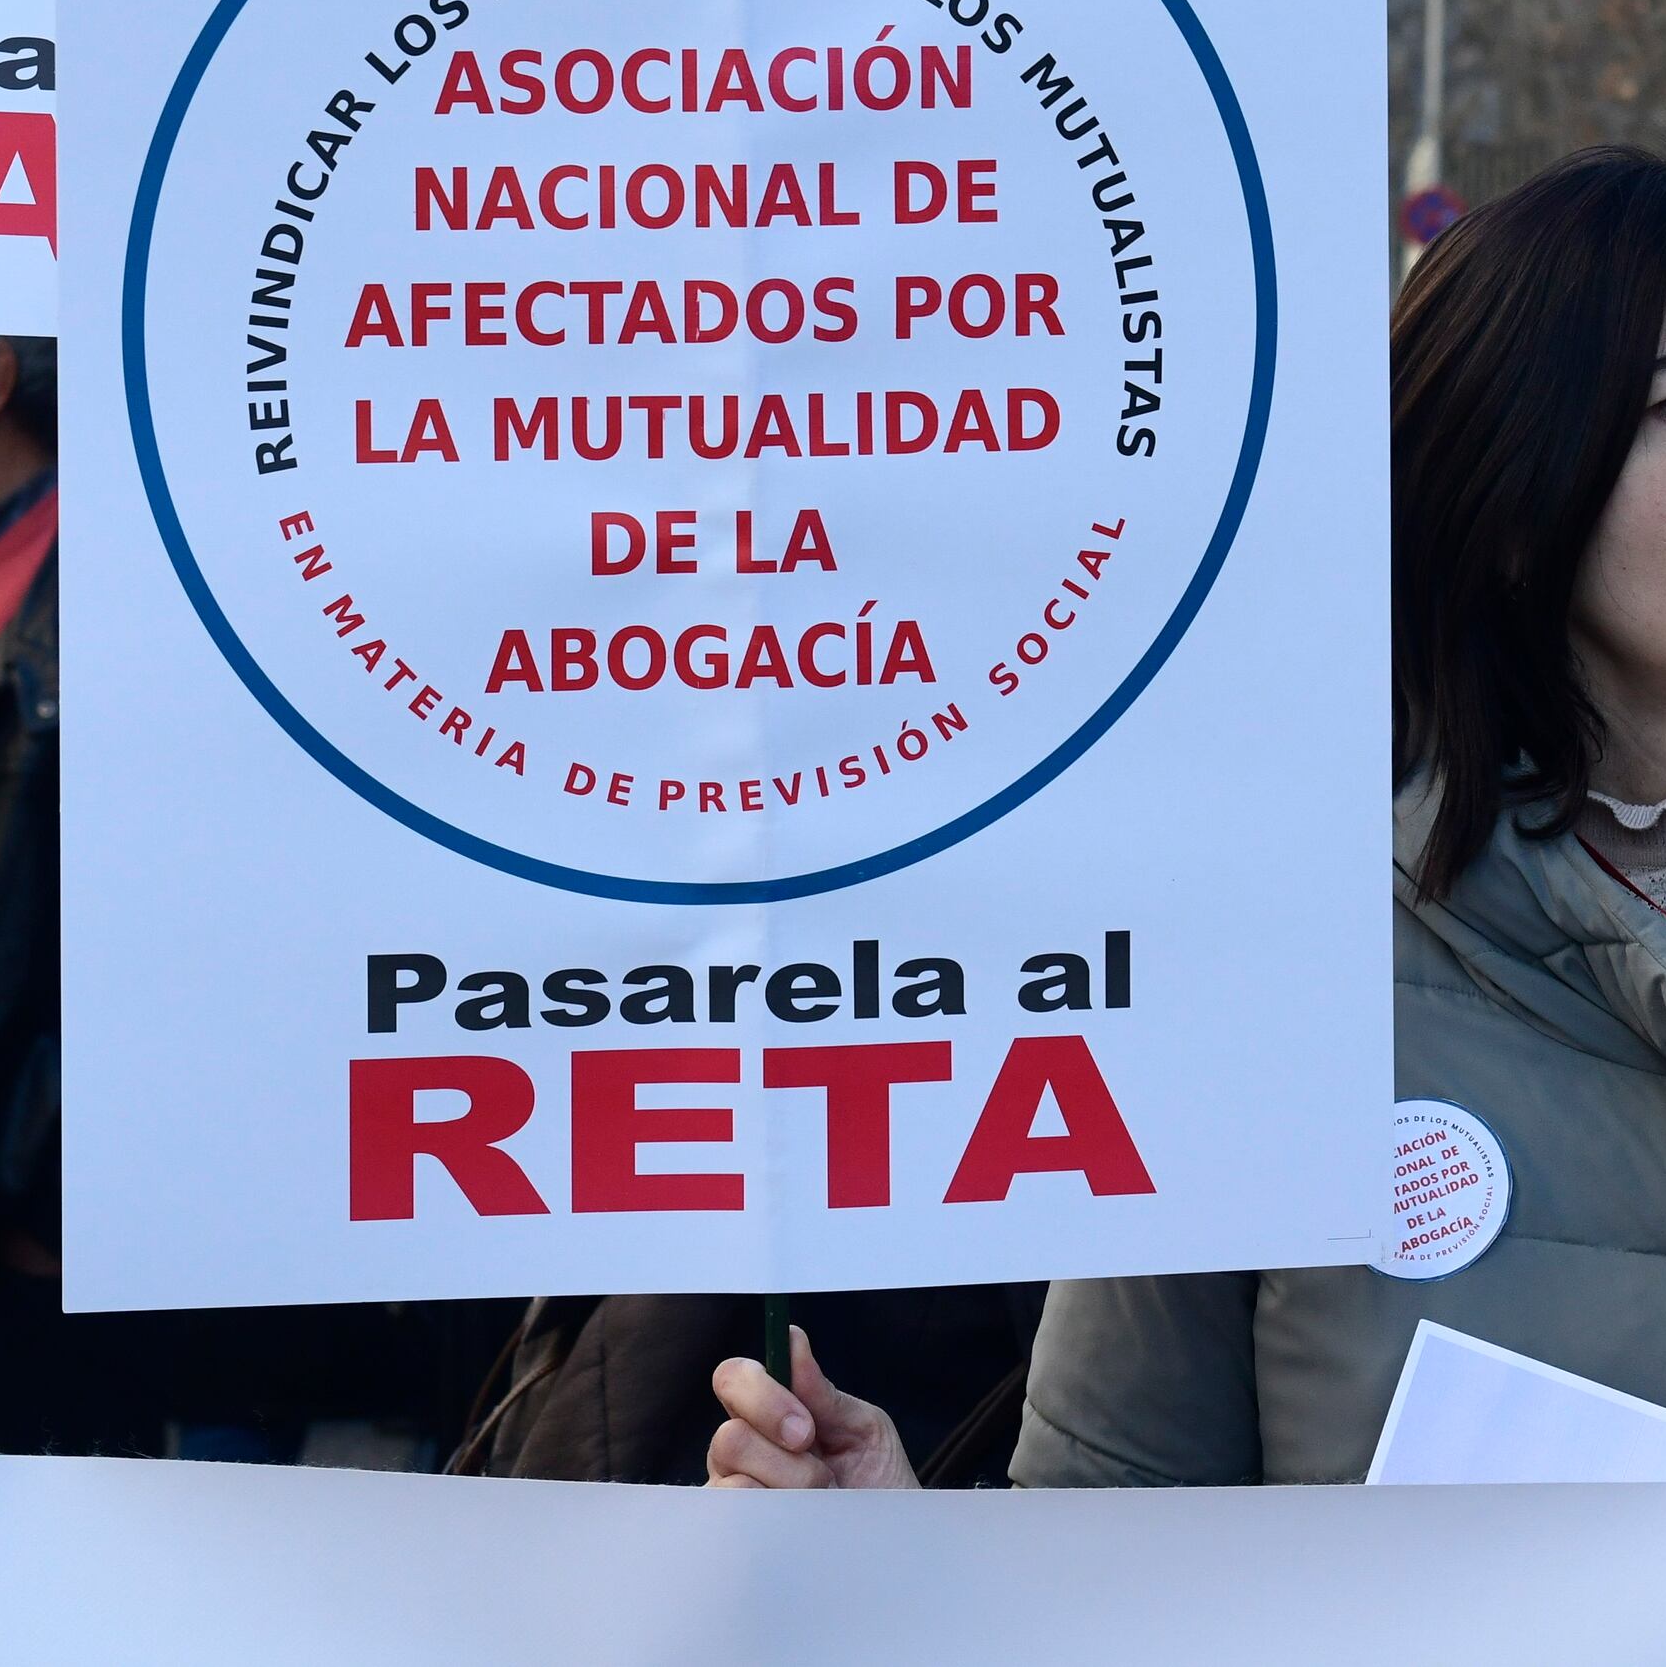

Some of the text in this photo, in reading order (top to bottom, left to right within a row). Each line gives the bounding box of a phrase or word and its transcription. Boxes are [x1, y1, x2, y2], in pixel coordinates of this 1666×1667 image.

[435, 25, 972, 115] ASOCIACIÓN
[415, 159, 999, 231] NACIONAL DE
[247, 90, 376, 475] REIVINDICAR
[1020, 53, 1163, 457] MUTUALISTAS
[345, 272, 1066, 348] AFECTADOS POR
[355, 388, 1061, 465] LA MUTUALIDAD
[590, 509, 838, 577] DE LA
[279, 510, 1126, 812] EN MATERIA DE PREVISIÓN SOCIAL
[485, 600, 936, 694] ABOGACÍA
[367, 930, 1131, 1033] Pasarela al
[349, 1035, 1157, 1222] RETA
[1430, 1116, 1448, 1126] LOS
[1451, 1123, 1495, 1178] MUTUALISTAS
[1441, 1145, 1460, 1160] DE
[1441, 1160, 1470, 1180] POR
[1400, 1216, 1474, 1253] ABOGACÍA
[1406, 1207, 1447, 1230] DE LA
[1419, 1253, 1431, 1261] DE
[1436, 1223, 1481, 1259] PREVISIÓN
[1478, 1185, 1494, 1222] SOCIAL
